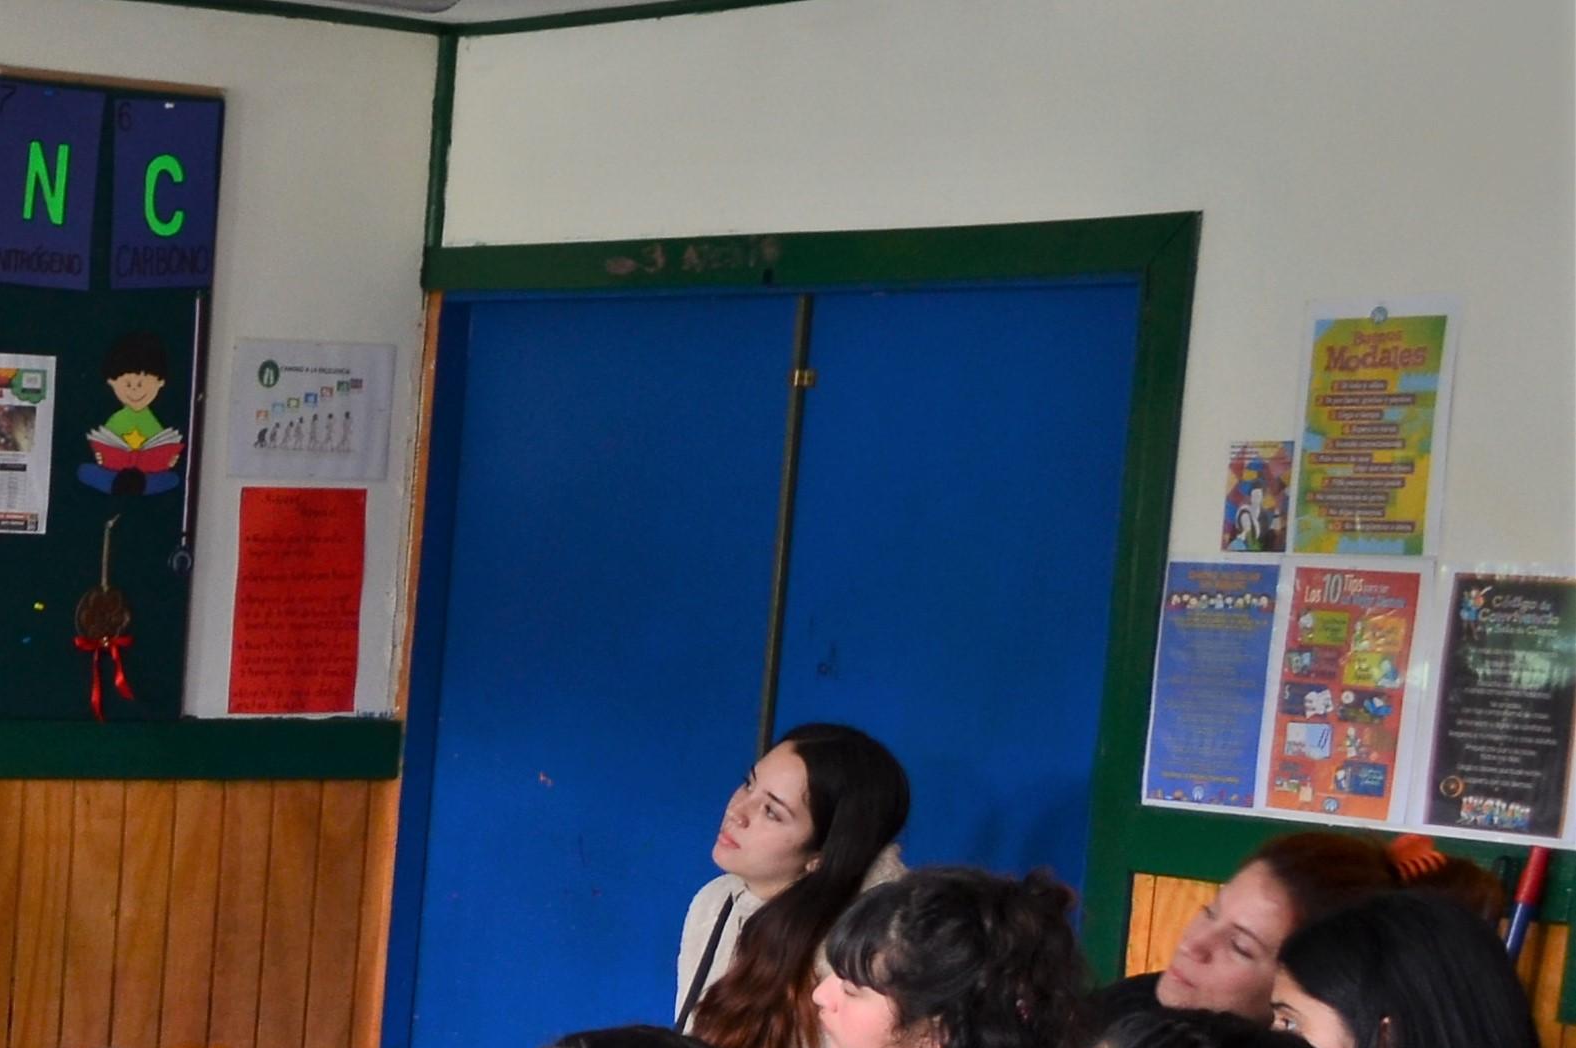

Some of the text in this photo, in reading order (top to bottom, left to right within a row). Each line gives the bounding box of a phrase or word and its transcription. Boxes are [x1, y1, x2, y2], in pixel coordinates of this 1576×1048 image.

[21, 140, 71, 226] N
[145, 154, 185, 238] C
[116, 245, 209, 277] CARBONO
[1324, 345, 1427, 372] Modales
[1304, 586, 1322, 604] Los
[1322, 573, 1344, 604] 10
[1343, 574, 1364, 595] Tips
